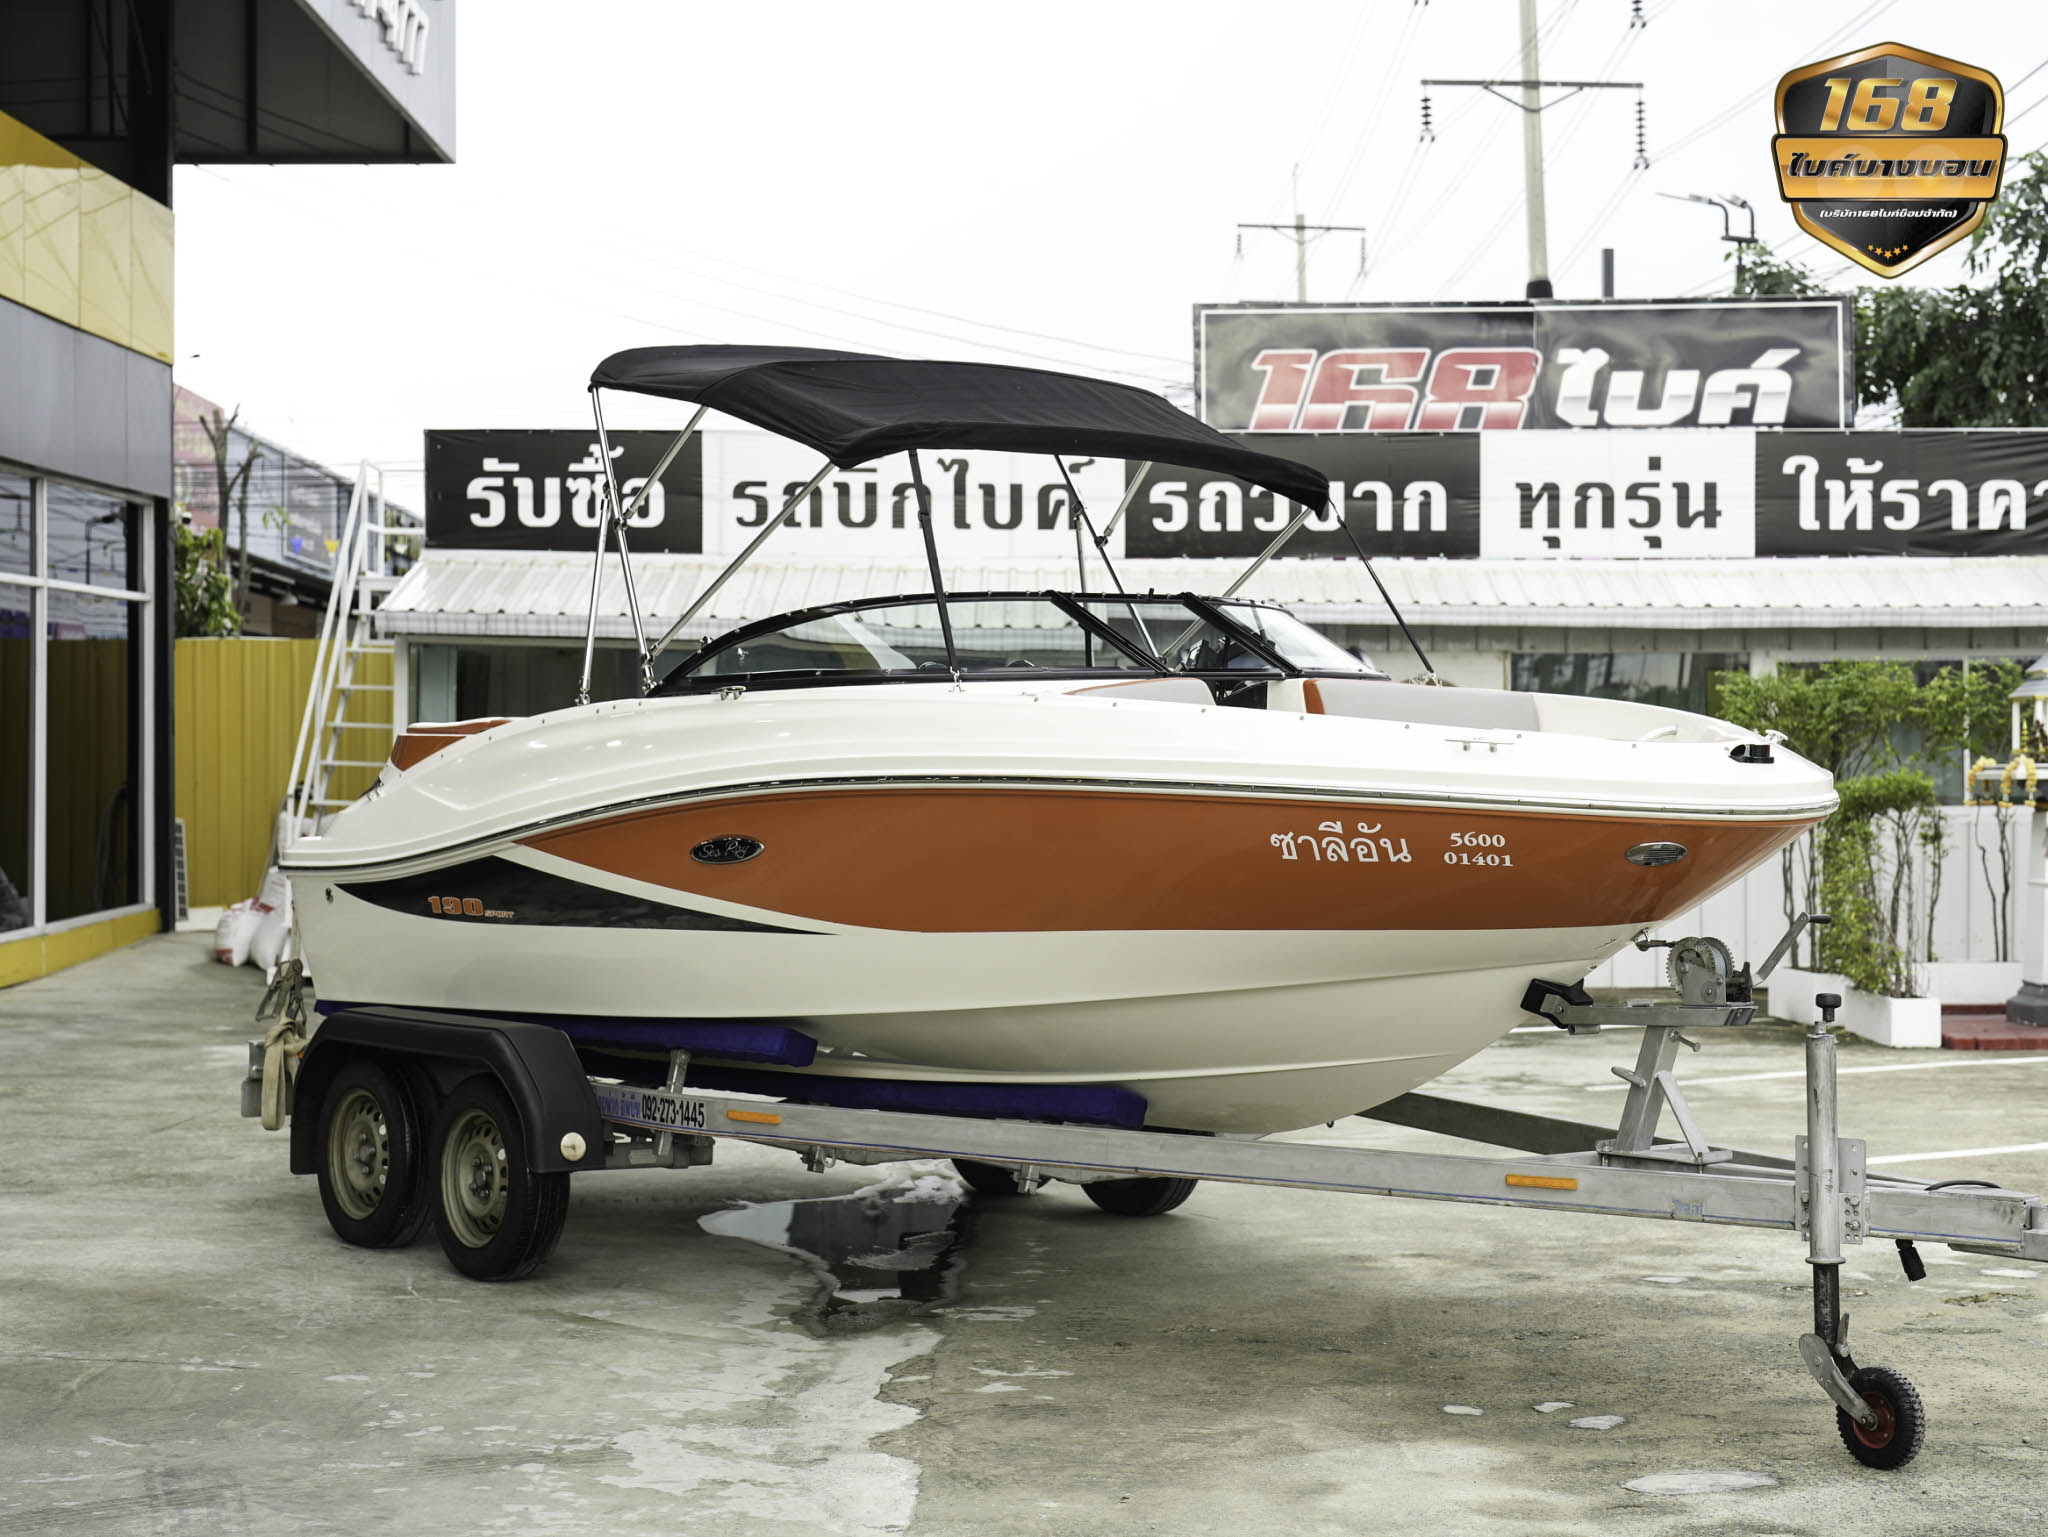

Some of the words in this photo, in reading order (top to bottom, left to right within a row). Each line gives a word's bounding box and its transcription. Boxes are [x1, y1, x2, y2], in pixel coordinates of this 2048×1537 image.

[1249, 348, 1543, 430] 168
[1555, 348, 1801, 426] ไบค์
[466, 443, 666, 528] รับซื้อ
[732, 457, 1096, 530] รถบิกไบค์
[1149, 480, 1448, 532] รถวบาก
[1515, 456, 1722, 549] ทุกรุ่น
[1269, 820, 1413, 862] ซาลีอัน
[1450, 831, 1506, 848] 5600
[1443, 851, 1515, 867] 01401
[427, 895, 484, 916] 190
[642, 1094, 705, 1128] 092-273-1445
